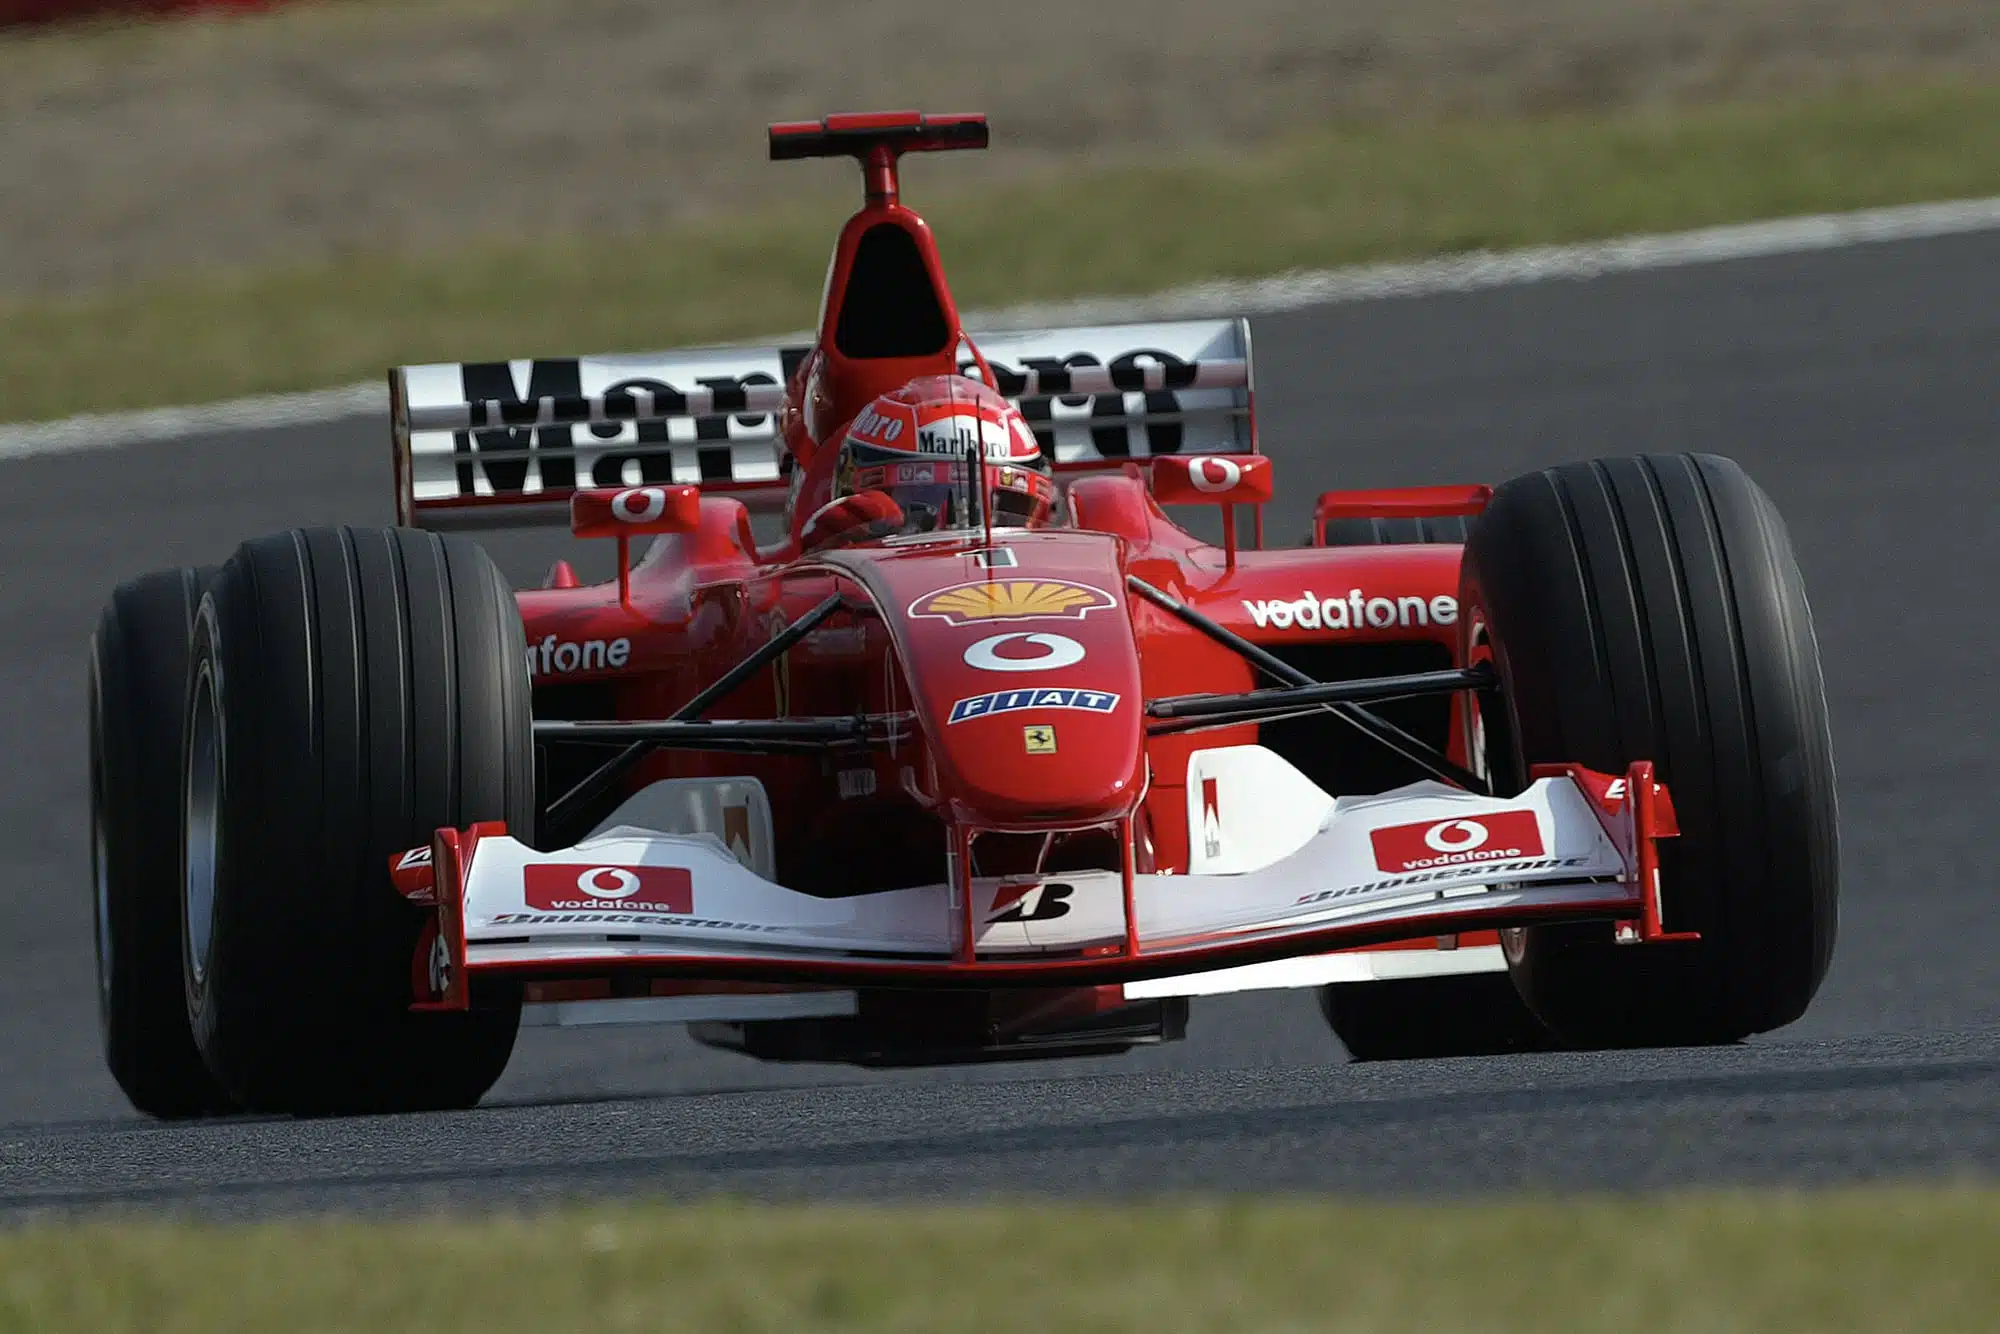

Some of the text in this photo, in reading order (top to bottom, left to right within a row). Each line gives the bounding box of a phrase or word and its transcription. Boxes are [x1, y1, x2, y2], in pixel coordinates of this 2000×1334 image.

[455, 347, 1198, 494] Marro
[1241, 589, 1458, 629] vodafone
[961, 691, 1108, 717] FIAT
[1403, 848, 1521, 870] vodafone
[551, 899, 670, 911] vodafone
